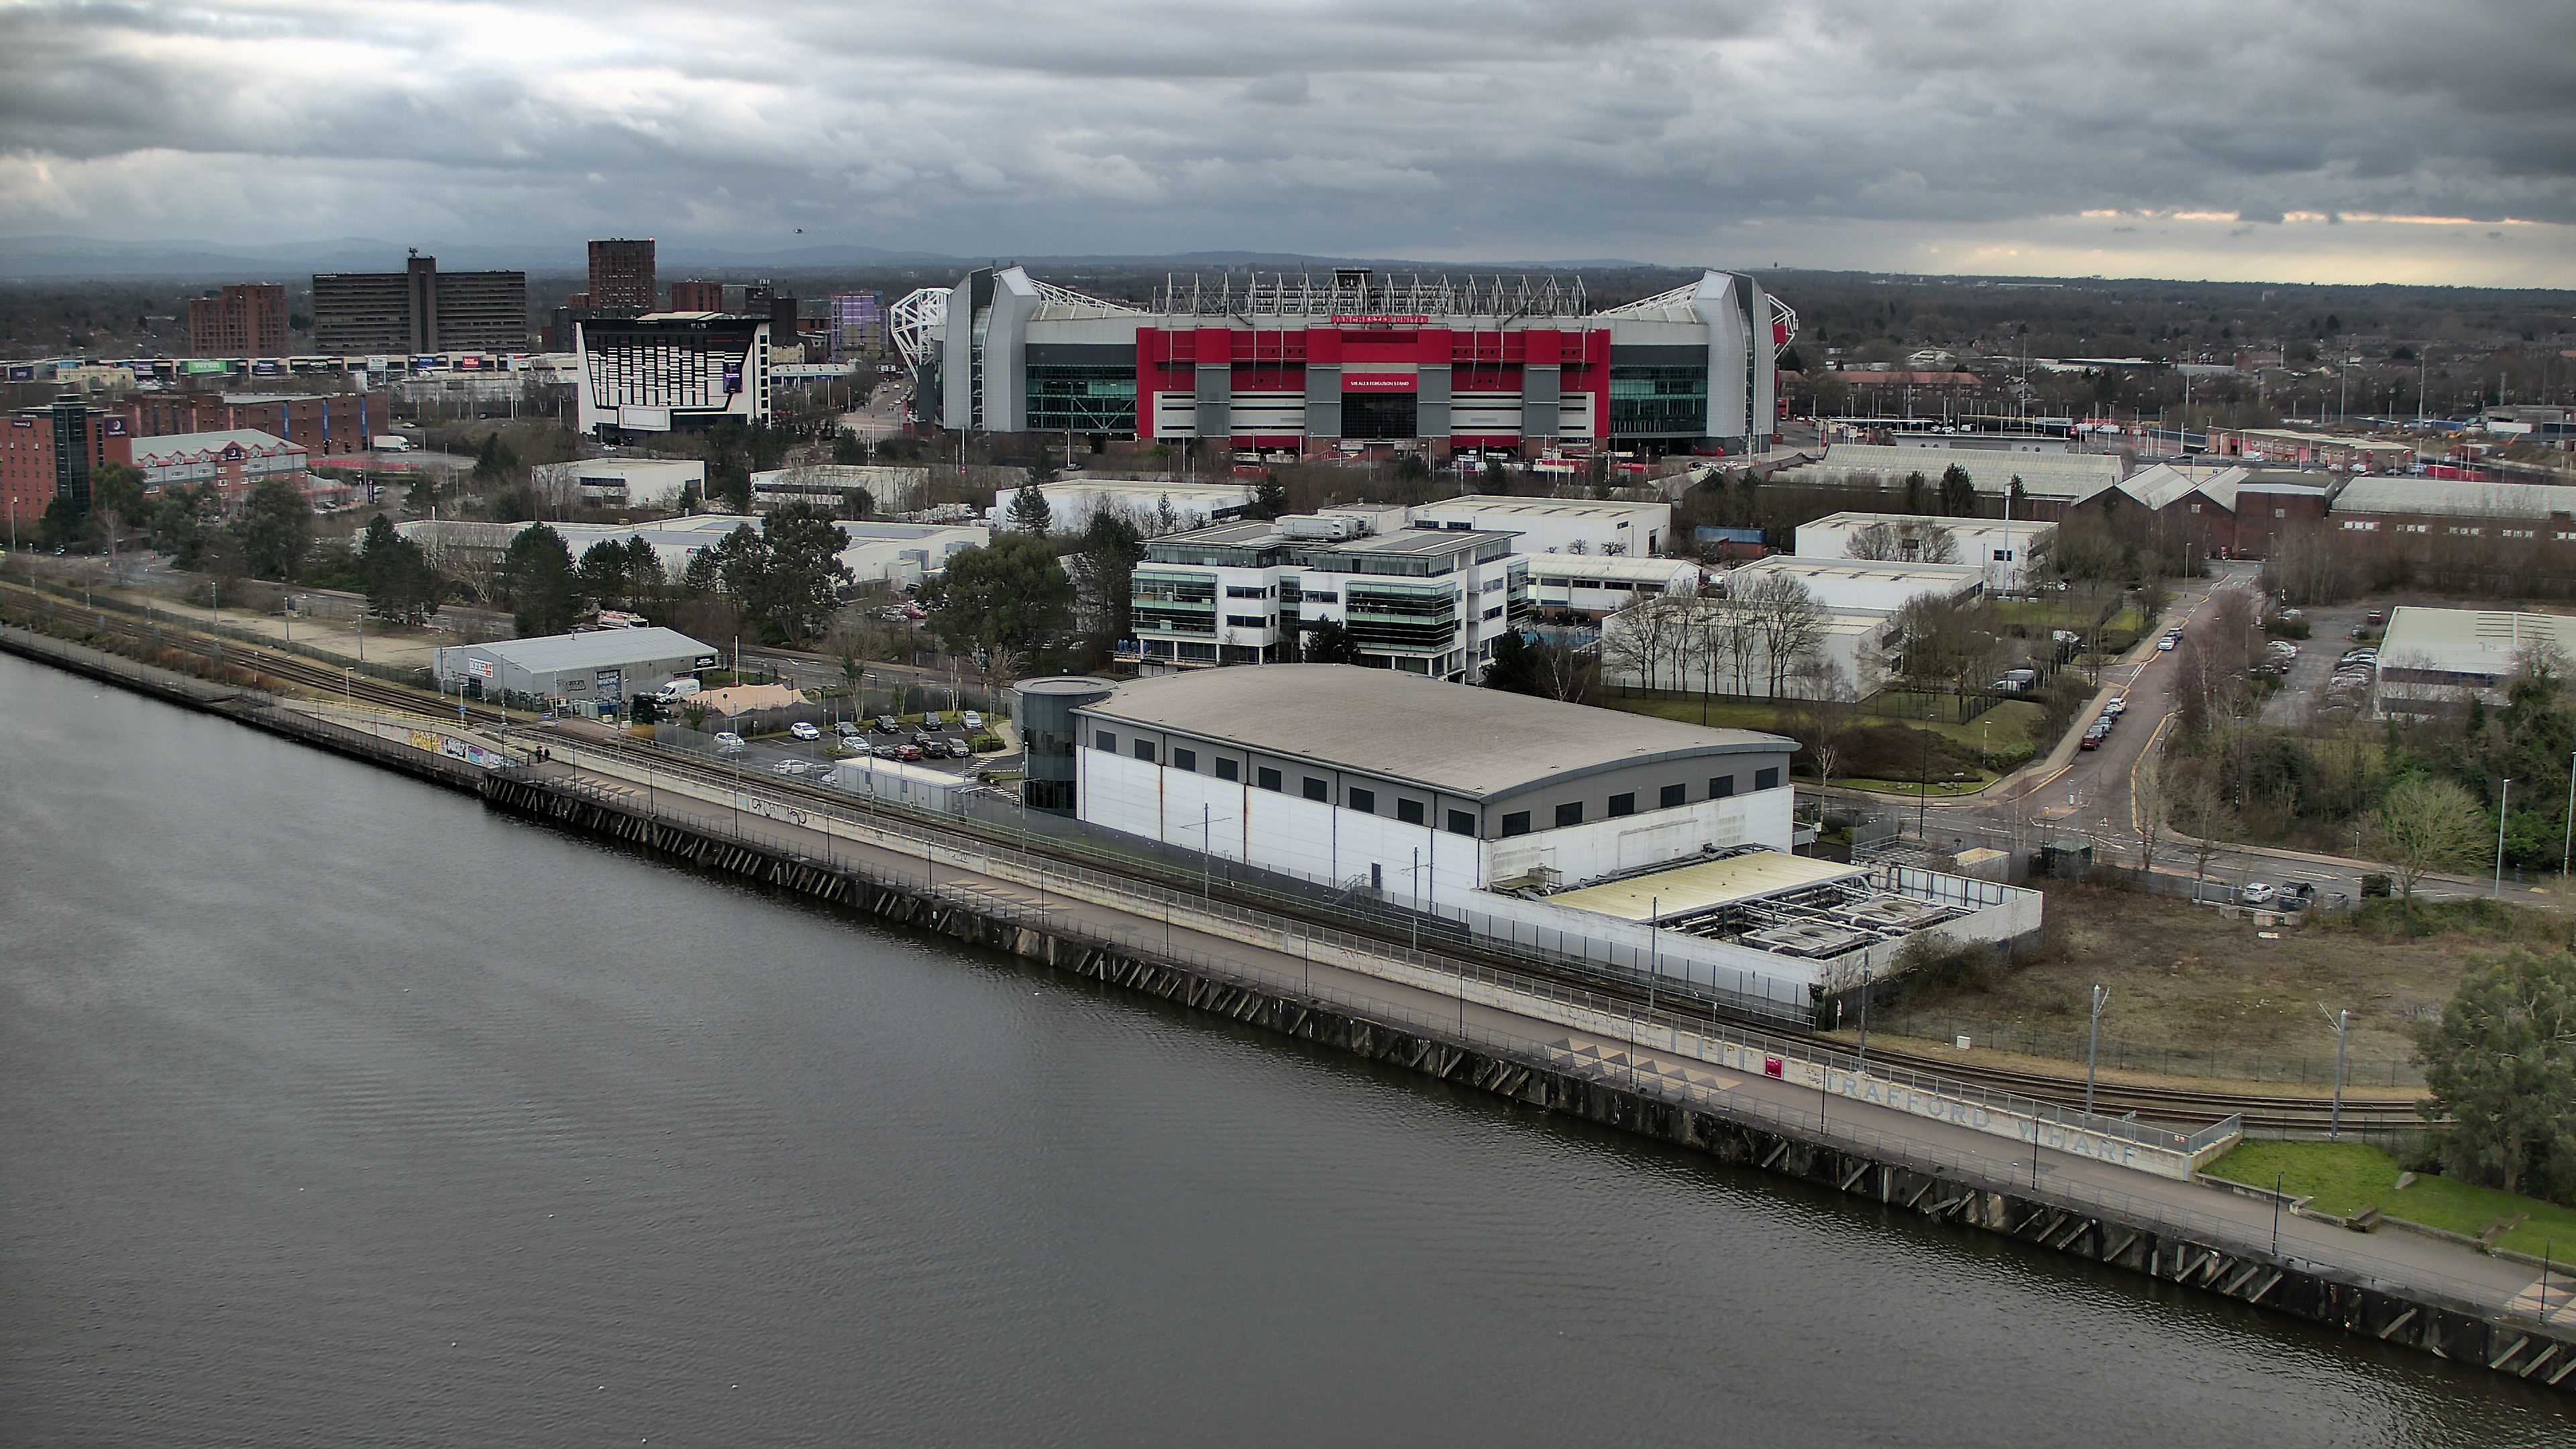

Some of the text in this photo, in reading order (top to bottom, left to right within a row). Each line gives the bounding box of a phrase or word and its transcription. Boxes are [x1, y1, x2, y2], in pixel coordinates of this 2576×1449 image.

[1331, 315, 1392, 323] MANCHESTER
[1825, 1073, 2139, 1165] TRAFFORD WHARF
